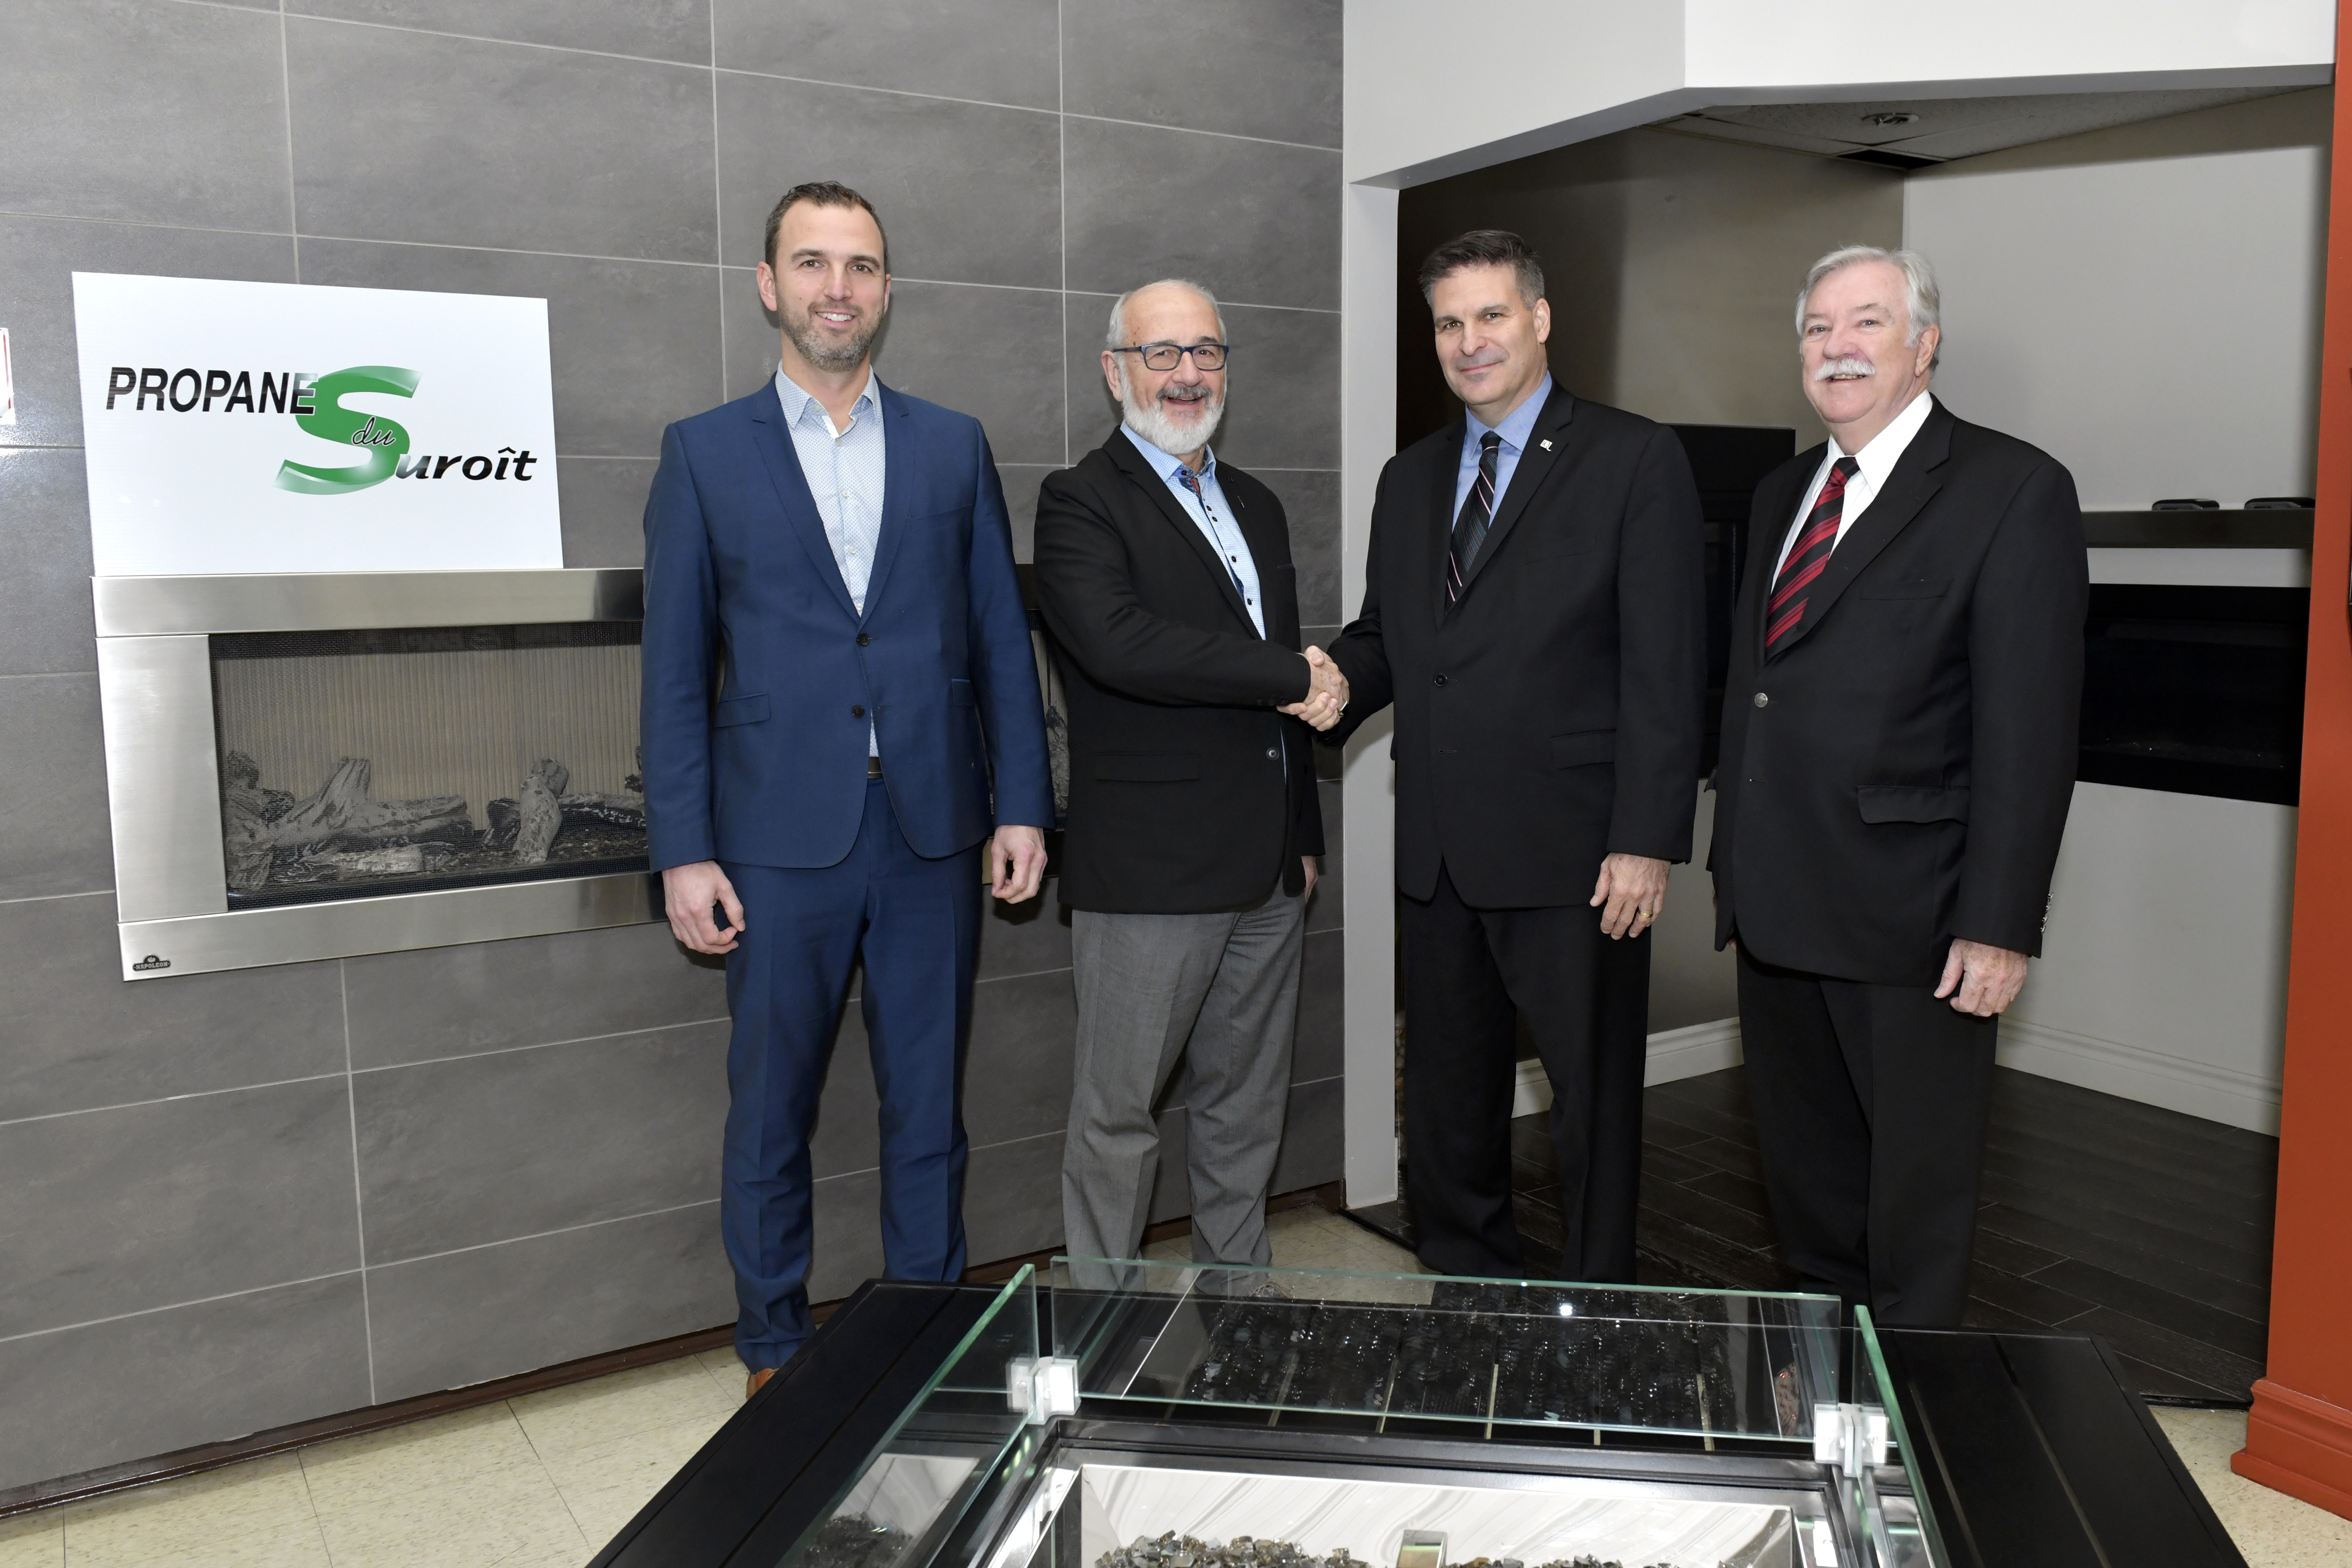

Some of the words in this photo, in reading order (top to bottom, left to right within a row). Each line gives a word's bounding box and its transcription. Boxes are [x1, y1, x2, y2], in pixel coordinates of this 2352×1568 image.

[106, 367, 318, 414] PROPANE
[274, 366, 537, 495] Suroît
[351, 416, 395, 447] du
[135, 962, 168, 970] NAPOLEON
